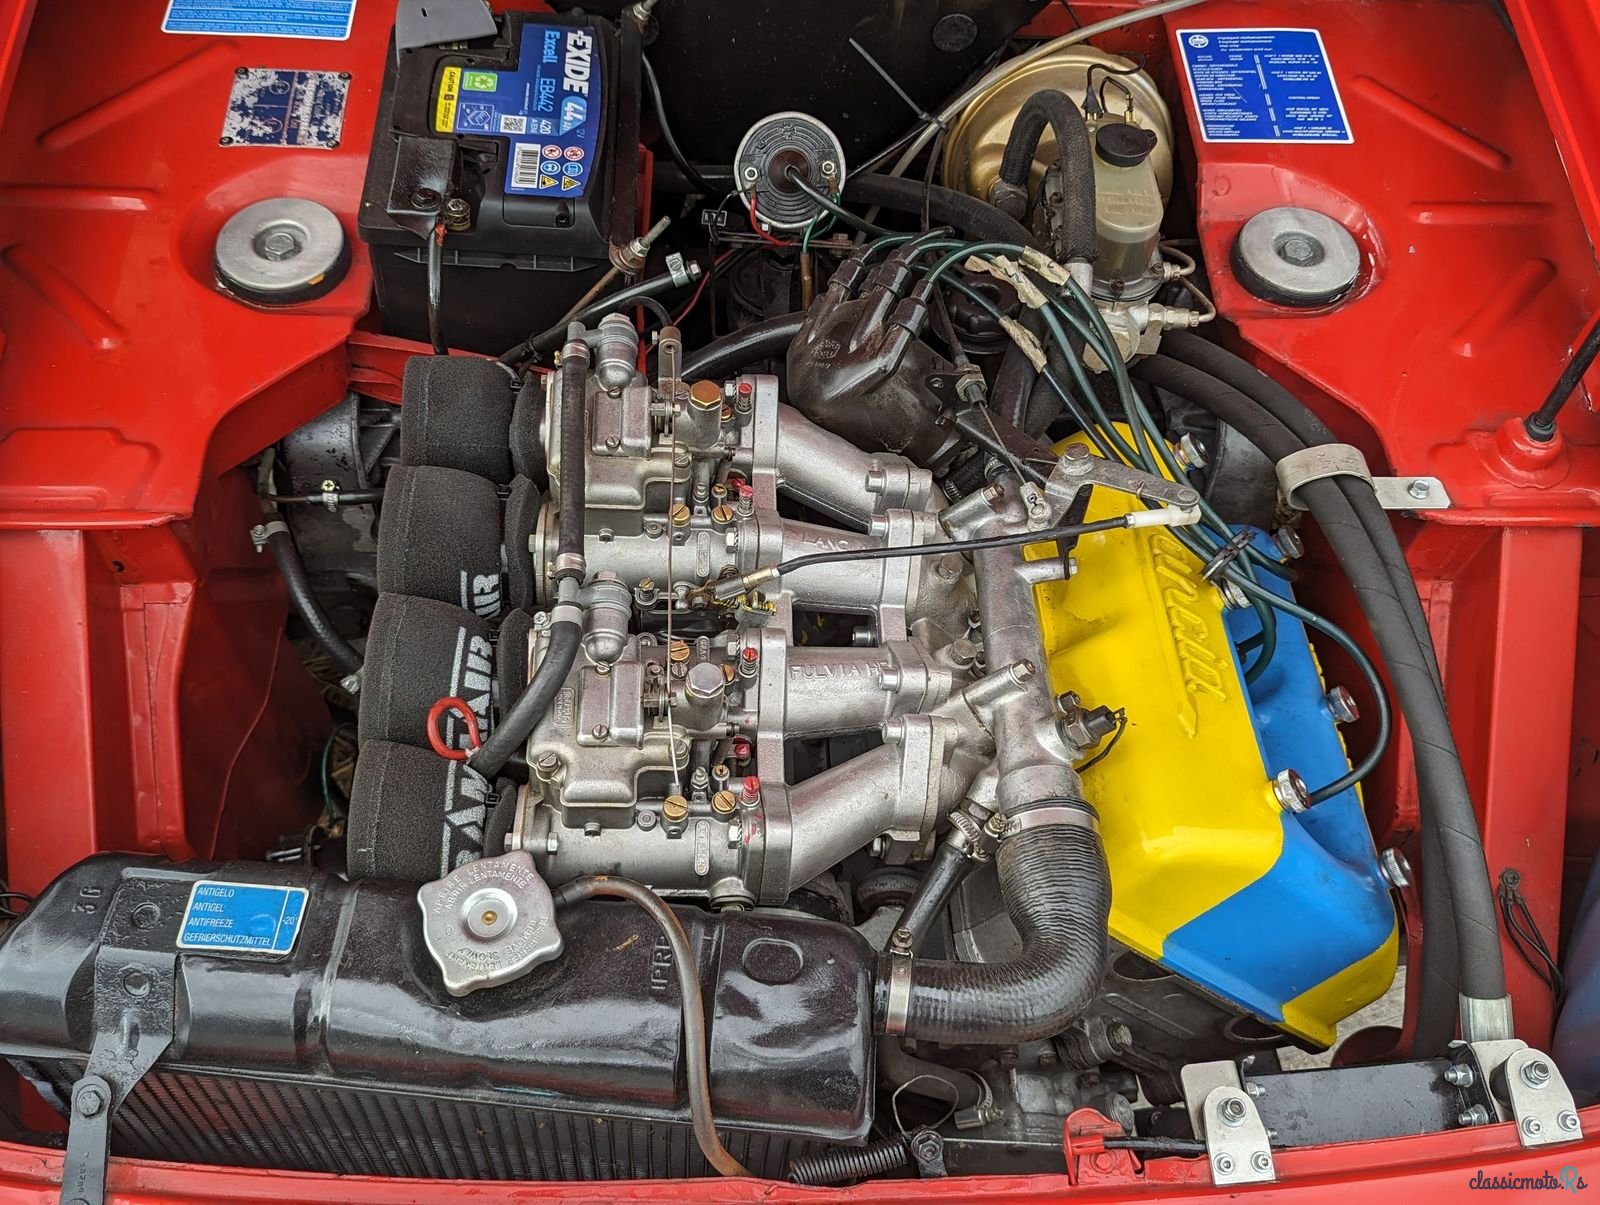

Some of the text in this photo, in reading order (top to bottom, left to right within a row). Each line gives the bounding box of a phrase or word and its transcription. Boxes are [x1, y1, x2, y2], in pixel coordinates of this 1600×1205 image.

[542, 30, 561, 64] Excell
[562, 30, 593, 94] EXIDE
[447, 71, 457, 92] CAUTION
[538, 77, 556, 112] EB442
[564, 101, 586, 121] 44
[539, 119, 552, 135] 420
[575, 128, 586, 139] 12V
[789, 663, 862, 681] FULVIA
[466, 861, 535, 883] LENTAMENTE
[196, 886, 235, 898] ANTIGELO
[444, 870, 528, 911] ABRIR LENTAMENTE
[192, 902, 225, 913] ANTIGEL
[188, 916, 233, 929] ANTIFREEZE
[183, 932, 272, 947] GEFRIERSCHUTZMITTEL
[457, 918, 538, 961] REMOVE SLOWLY
